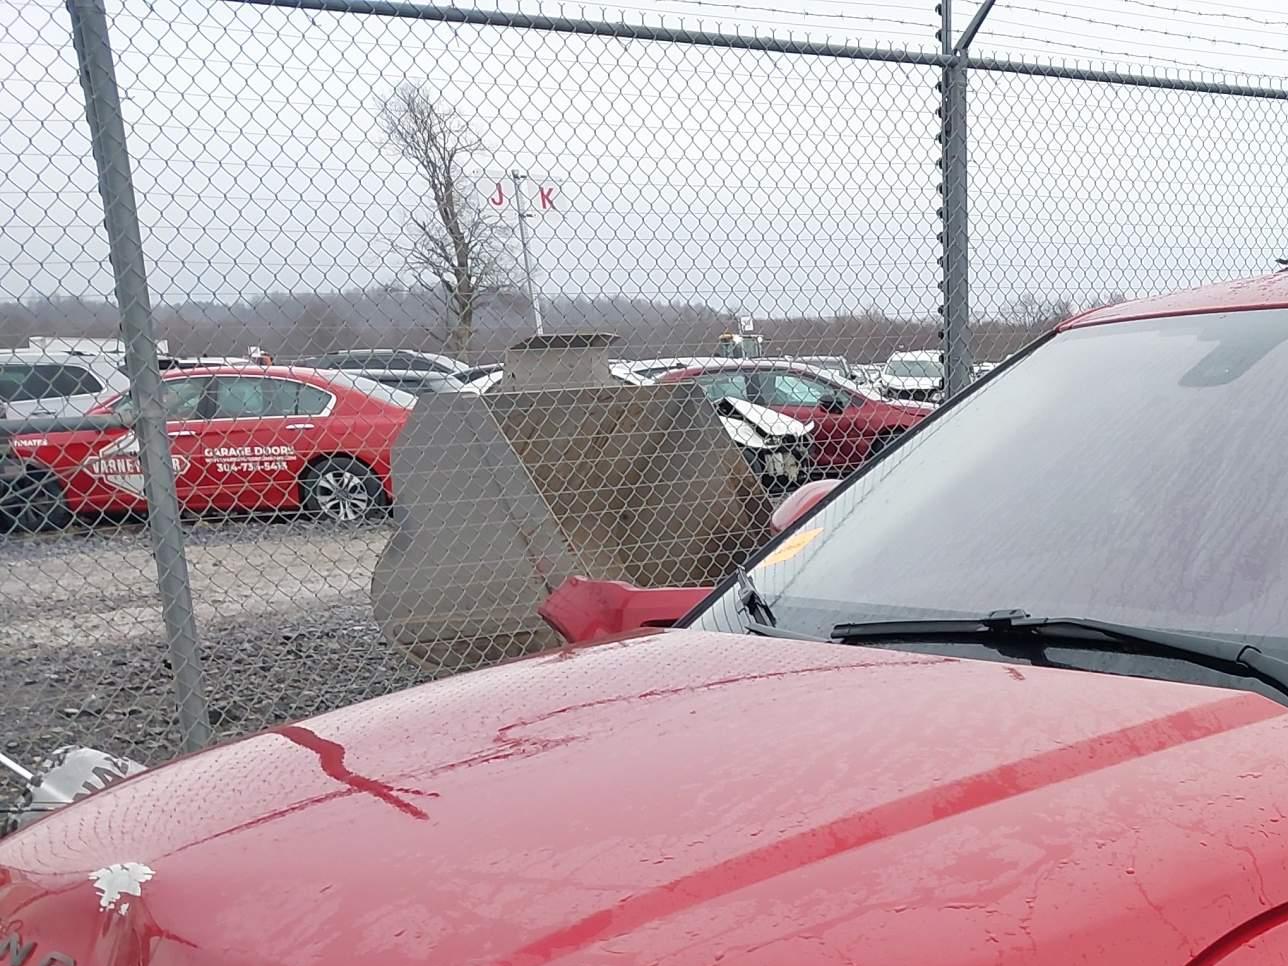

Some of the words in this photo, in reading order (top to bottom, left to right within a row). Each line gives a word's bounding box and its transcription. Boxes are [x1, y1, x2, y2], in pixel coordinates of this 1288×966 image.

[491, 182, 504, 206] J
[539, 186, 556, 210] K
[204, 447, 252, 457] GARAGE
